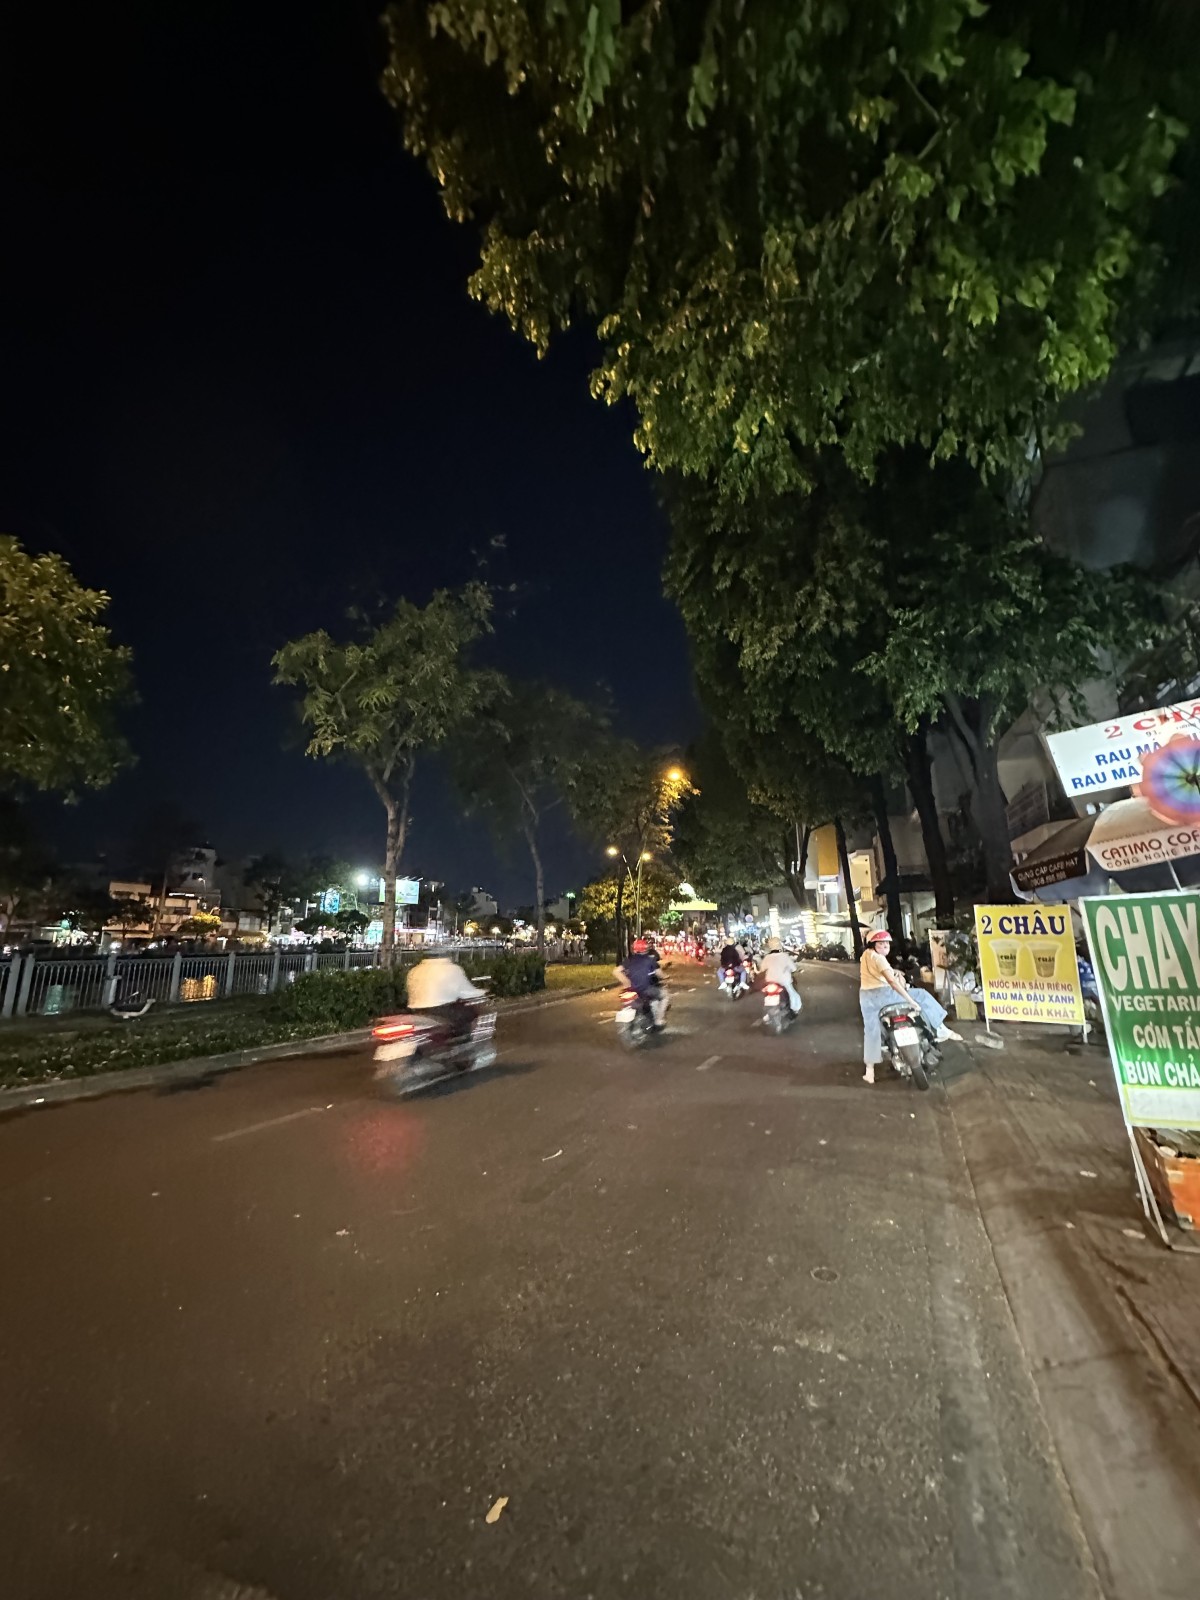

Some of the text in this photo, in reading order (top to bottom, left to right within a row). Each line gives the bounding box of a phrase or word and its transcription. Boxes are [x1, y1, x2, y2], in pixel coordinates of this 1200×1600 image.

[1104, 725, 1122, 739] 2
[1095, 748, 1131, 766] RAU
[1071, 762, 1140, 789] RAU MÁ
[1101, 838, 1162, 861] CATIMO
[981, 910, 1065, 935] 2 CHÂU
[1096, 902, 1200, 991] CHAY
[990, 991, 1008, 1001] RAU
[1048, 994, 1075, 1005] XANH
[1110, 994, 1200, 1012] VEGETARI
[991, 1004, 1019, 1016] NƯỚC
[1132, 1021, 1171, 1049] CƠM
[1125, 1053, 1200, 1087] BÚN CHẢ
